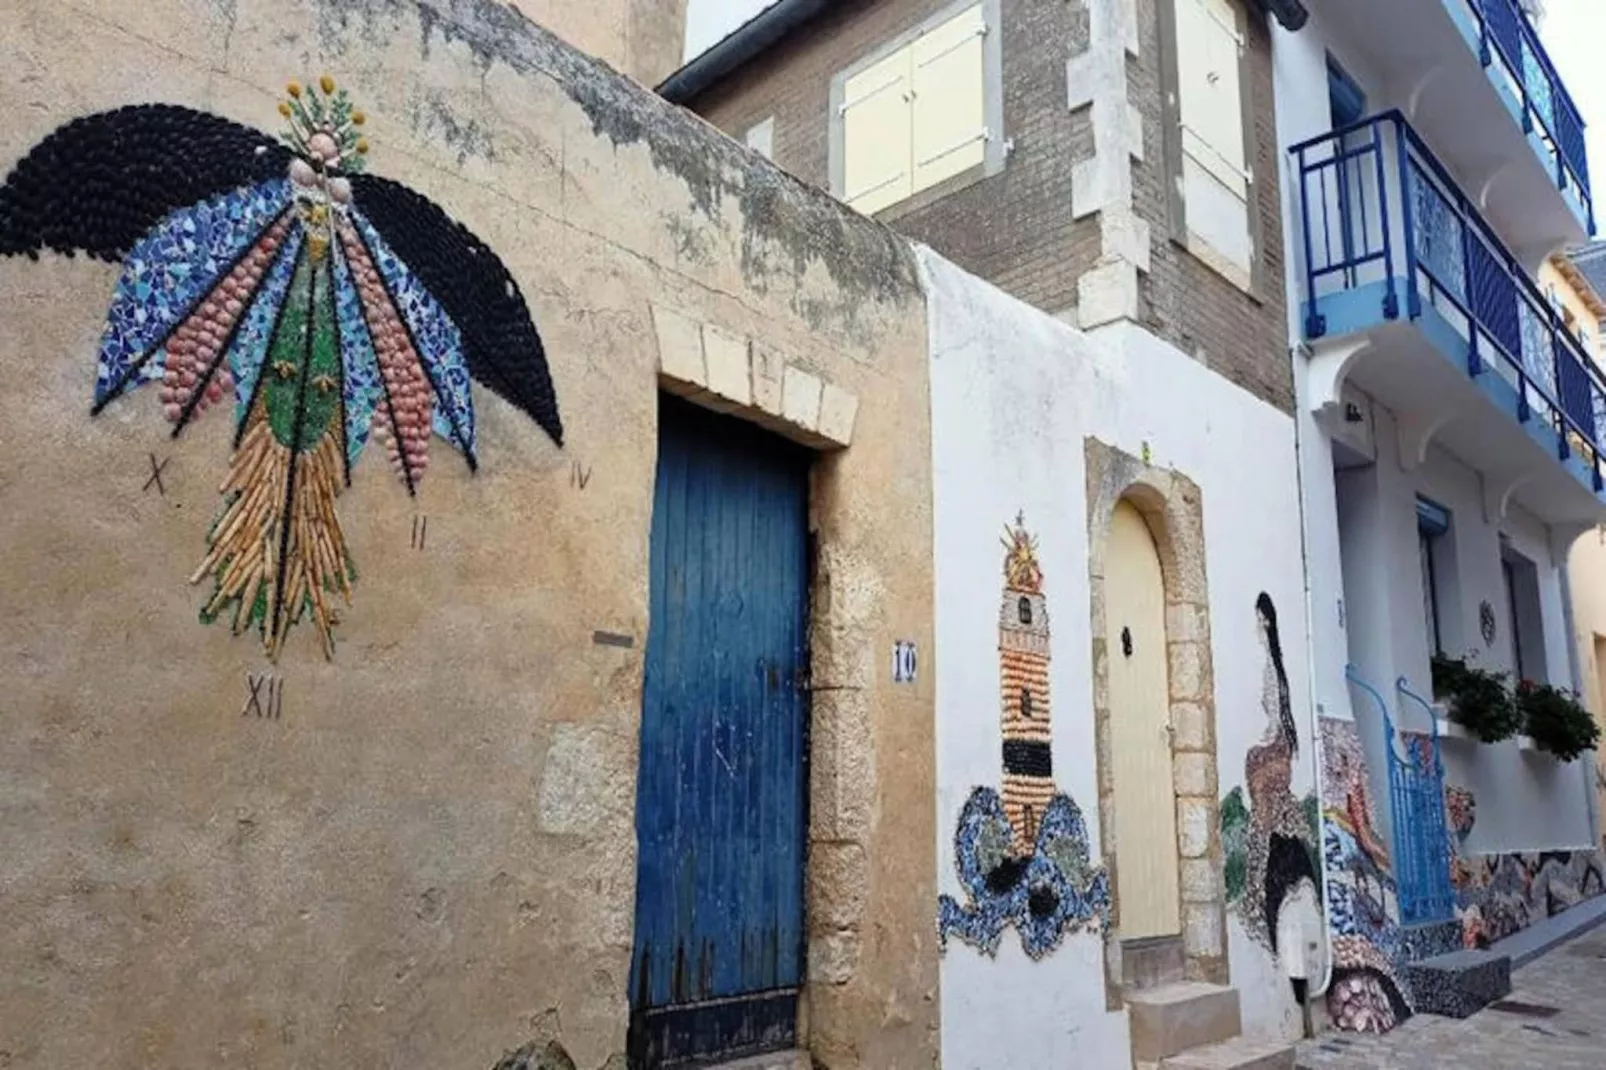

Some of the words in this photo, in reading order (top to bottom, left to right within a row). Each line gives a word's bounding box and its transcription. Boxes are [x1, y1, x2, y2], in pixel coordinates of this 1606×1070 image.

[142, 452, 171, 496] X
[570, 459, 592, 490] IV
[411, 514, 427, 551] II
[894, 640, 916, 683] 10
[241, 674, 284, 721] XII
